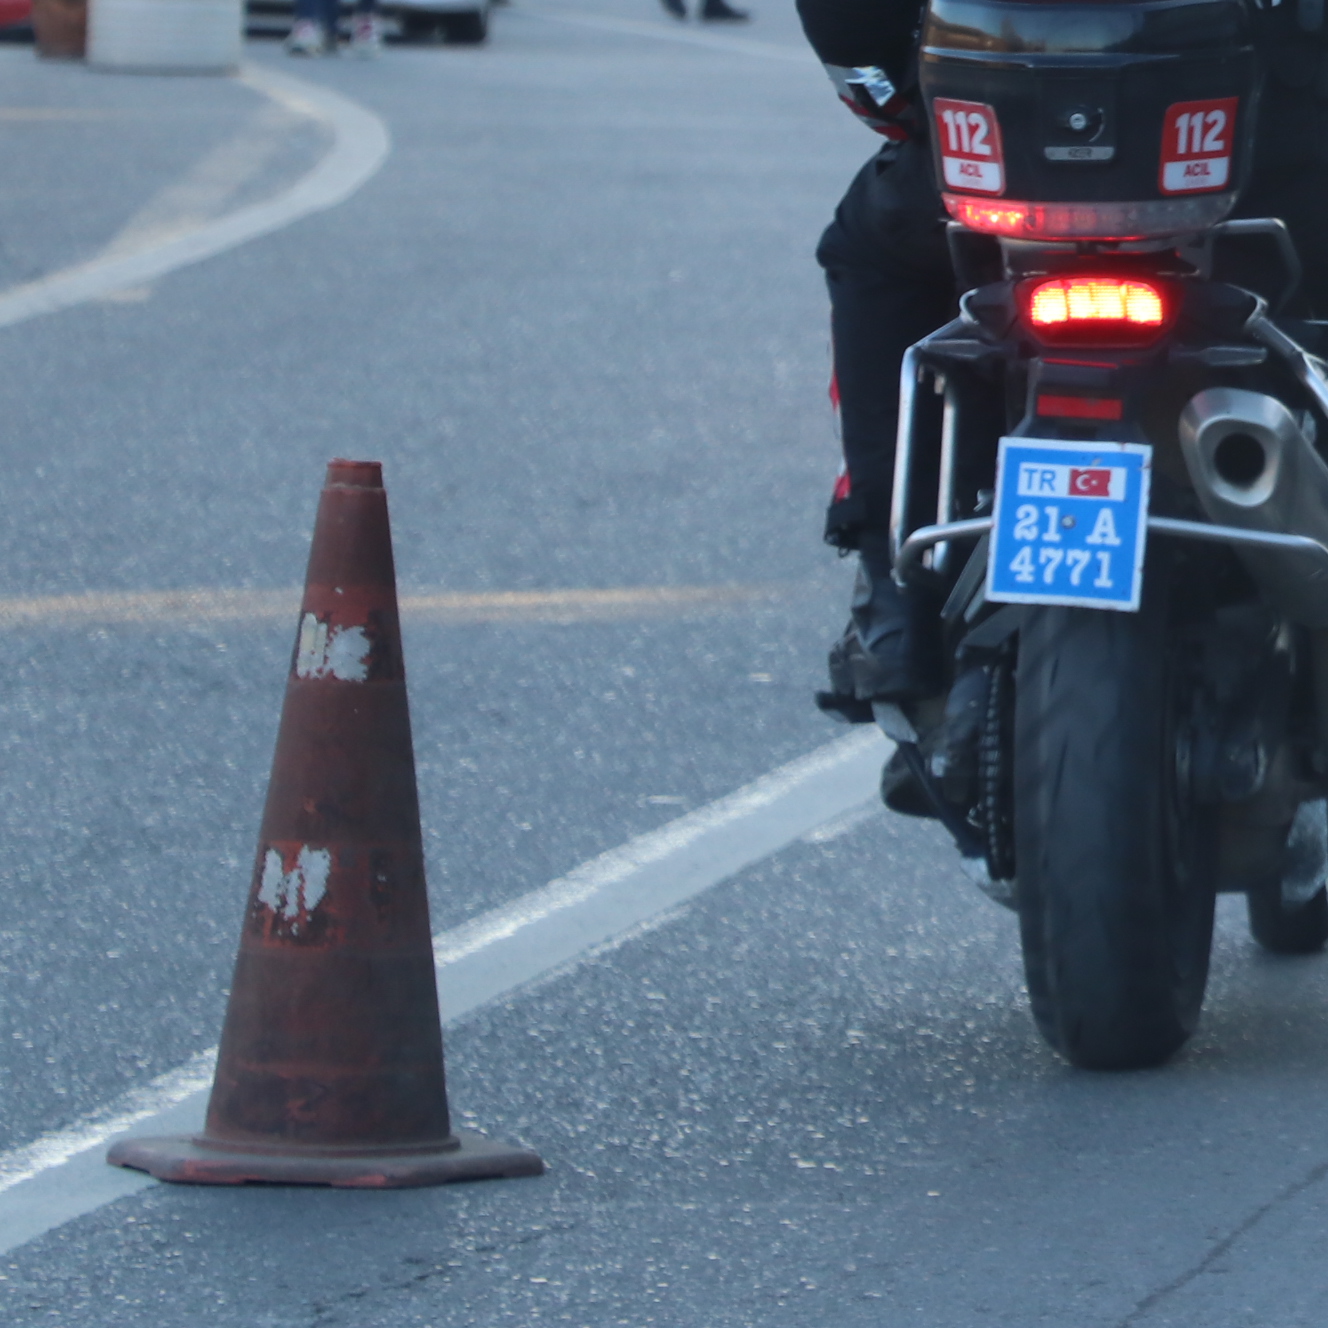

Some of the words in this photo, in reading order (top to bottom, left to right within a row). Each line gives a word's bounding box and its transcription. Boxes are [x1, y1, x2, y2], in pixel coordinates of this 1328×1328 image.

[943, 109, 992, 157] 112
[1175, 108, 1228, 155] 112
[1023, 468, 1056, 492] TR
[1013, 504, 1062, 542] 21
[1085, 508, 1122, 546] A
[1009, 545, 1113, 588] 4771
